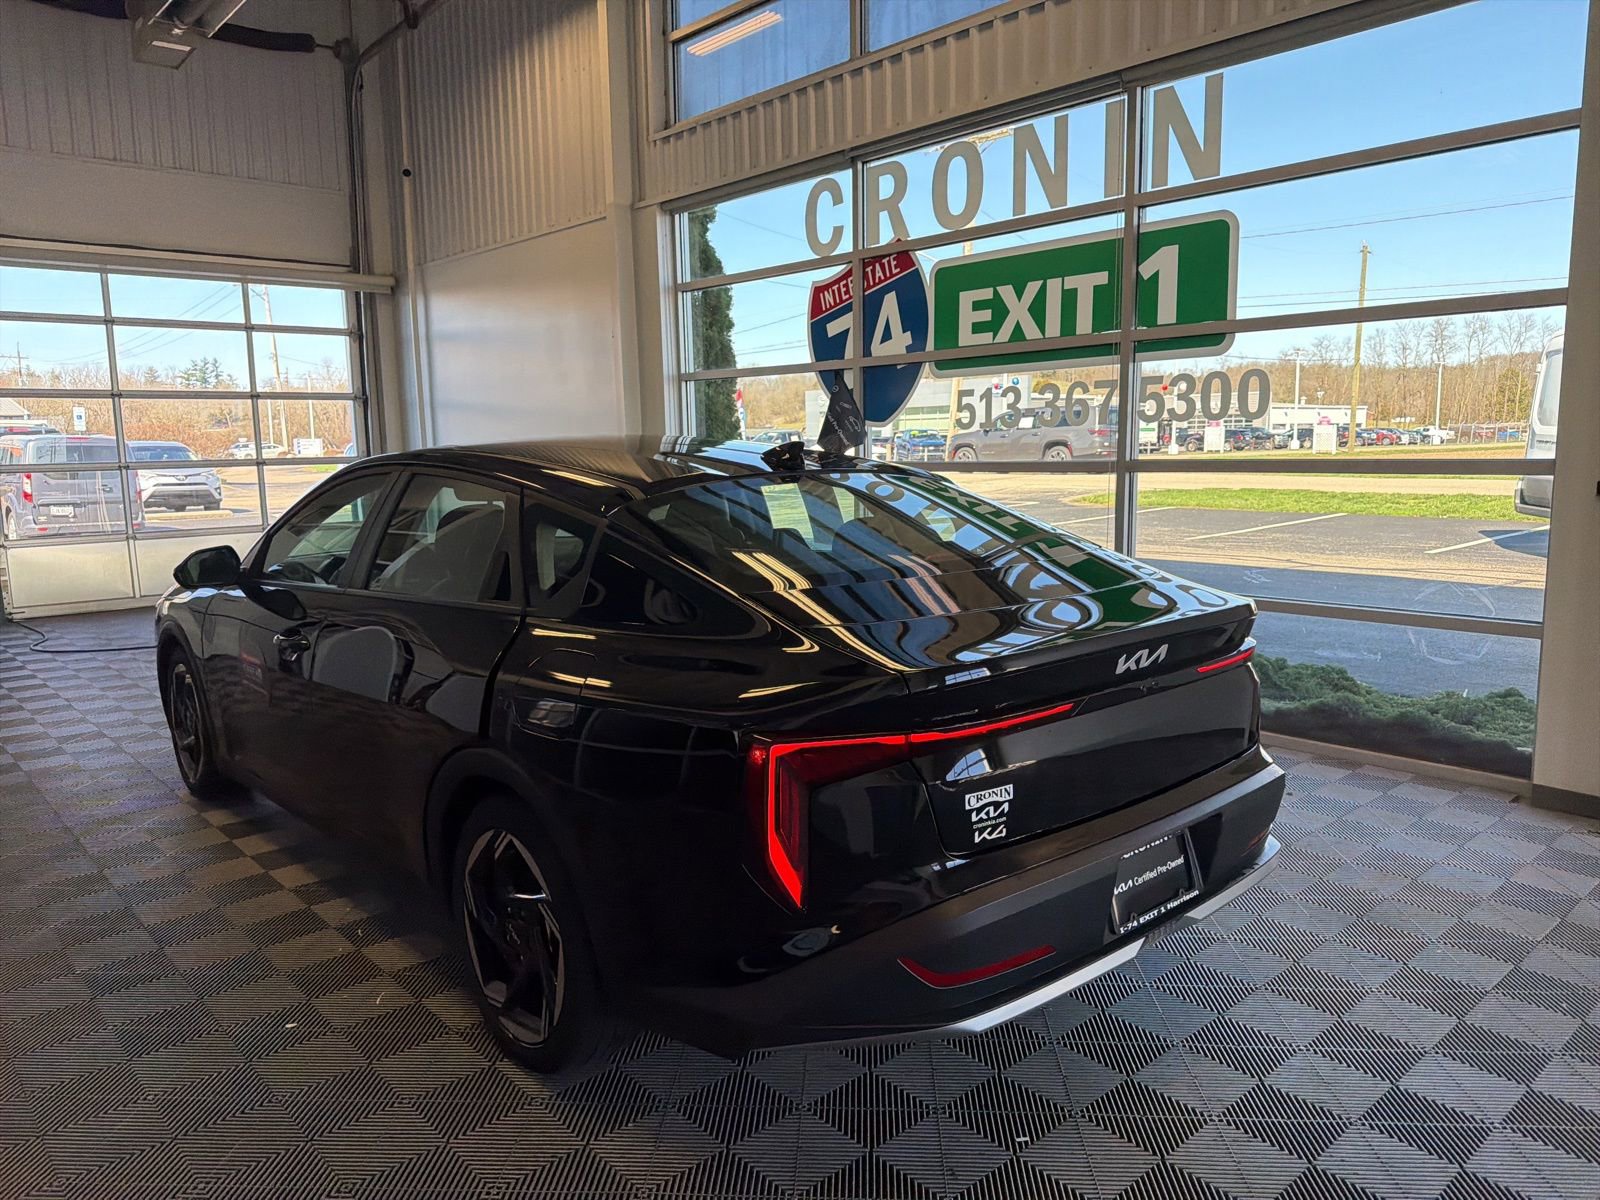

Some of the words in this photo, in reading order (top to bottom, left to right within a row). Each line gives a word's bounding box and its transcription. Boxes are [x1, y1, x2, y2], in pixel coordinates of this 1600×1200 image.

[804, 72, 1224, 258] CRONIN
[819, 253, 901, 312] INTETATE
[957, 271, 1109, 347] EXIT
[1138, 244, 1179, 325] 1
[825, 290, 913, 390] 74
[1115, 643, 1169, 675] KIA
[967, 785, 1012, 808] CRONIN
[971, 801, 1009, 822] KIA
[1133, 868, 1157, 886] Certified
[1157, 854, 1185, 875] Pre-Owned
[1119, 920, 1138, 934] I-74
[1140, 909, 1159, 924] EXIT
[1167, 889, 1200, 910] Harrison
